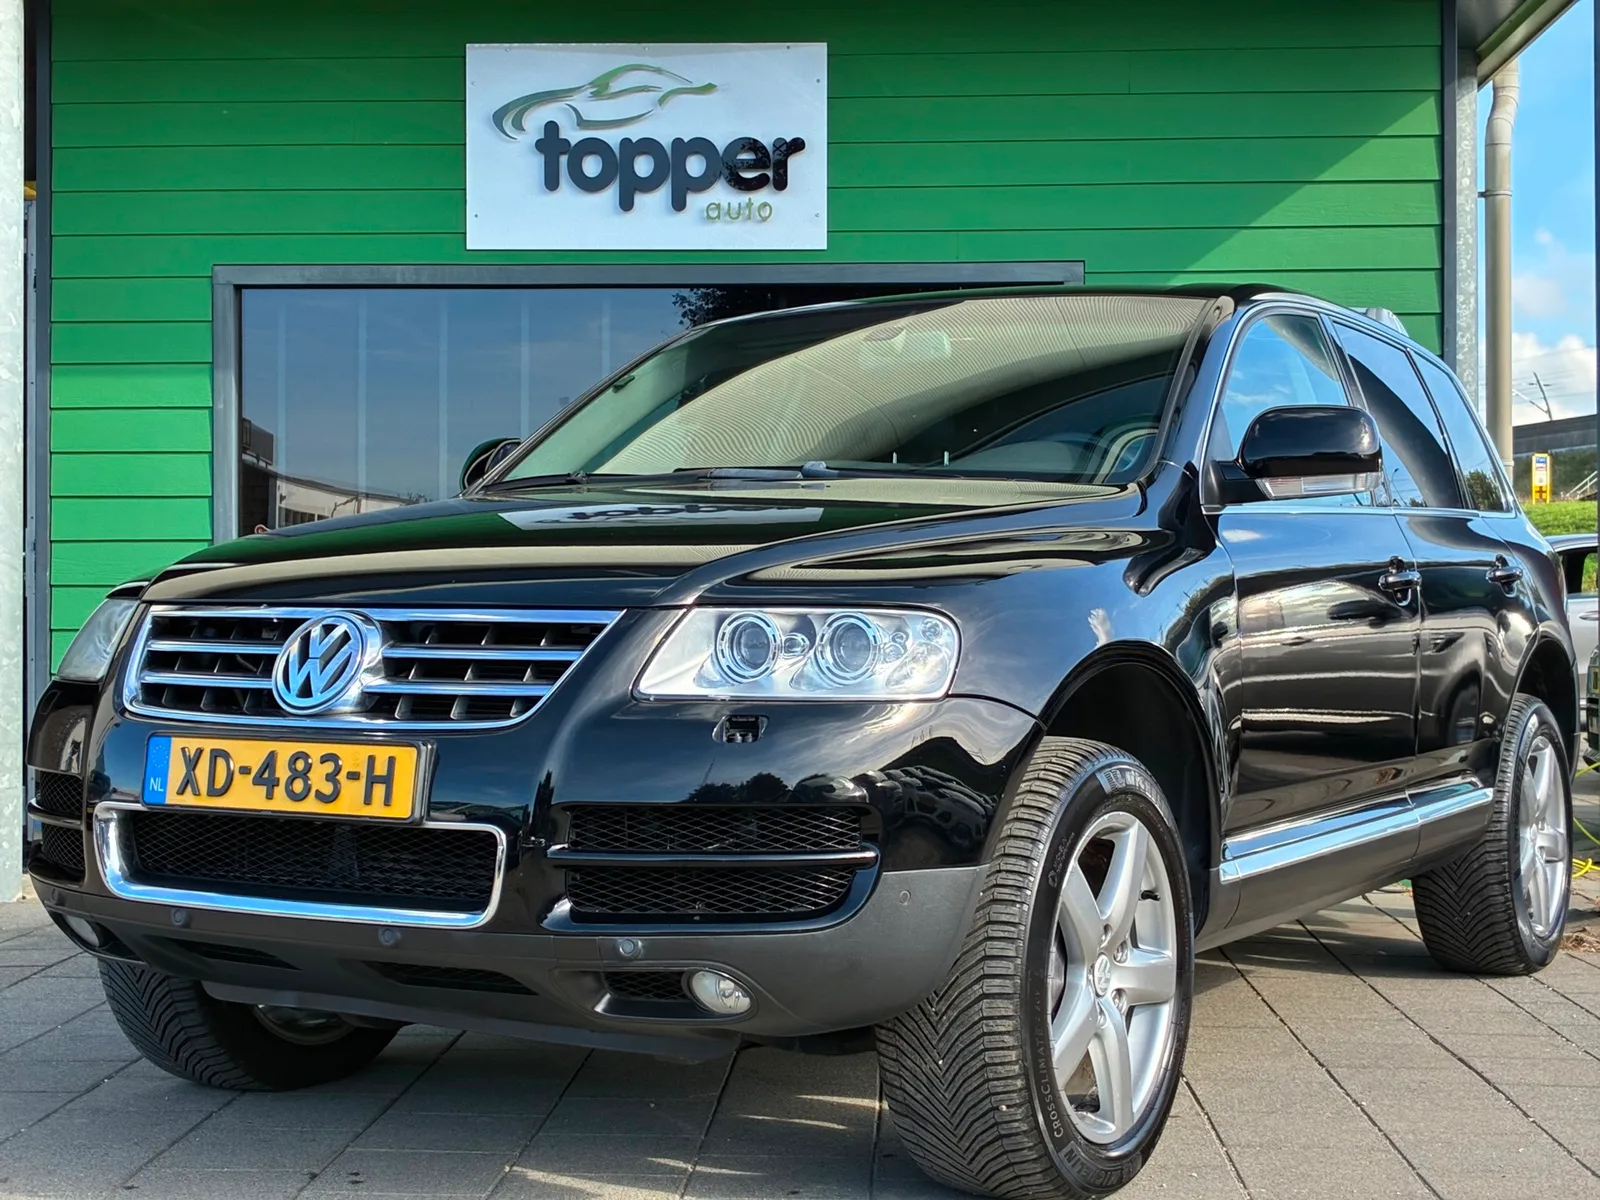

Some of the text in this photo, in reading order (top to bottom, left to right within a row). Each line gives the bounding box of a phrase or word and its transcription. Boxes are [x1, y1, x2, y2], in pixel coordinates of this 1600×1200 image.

[535, 120, 806, 212] topper
[705, 197, 773, 222] auto
[150, 776, 165, 793] NL
[176, 746, 396, 806] XD-483-H
